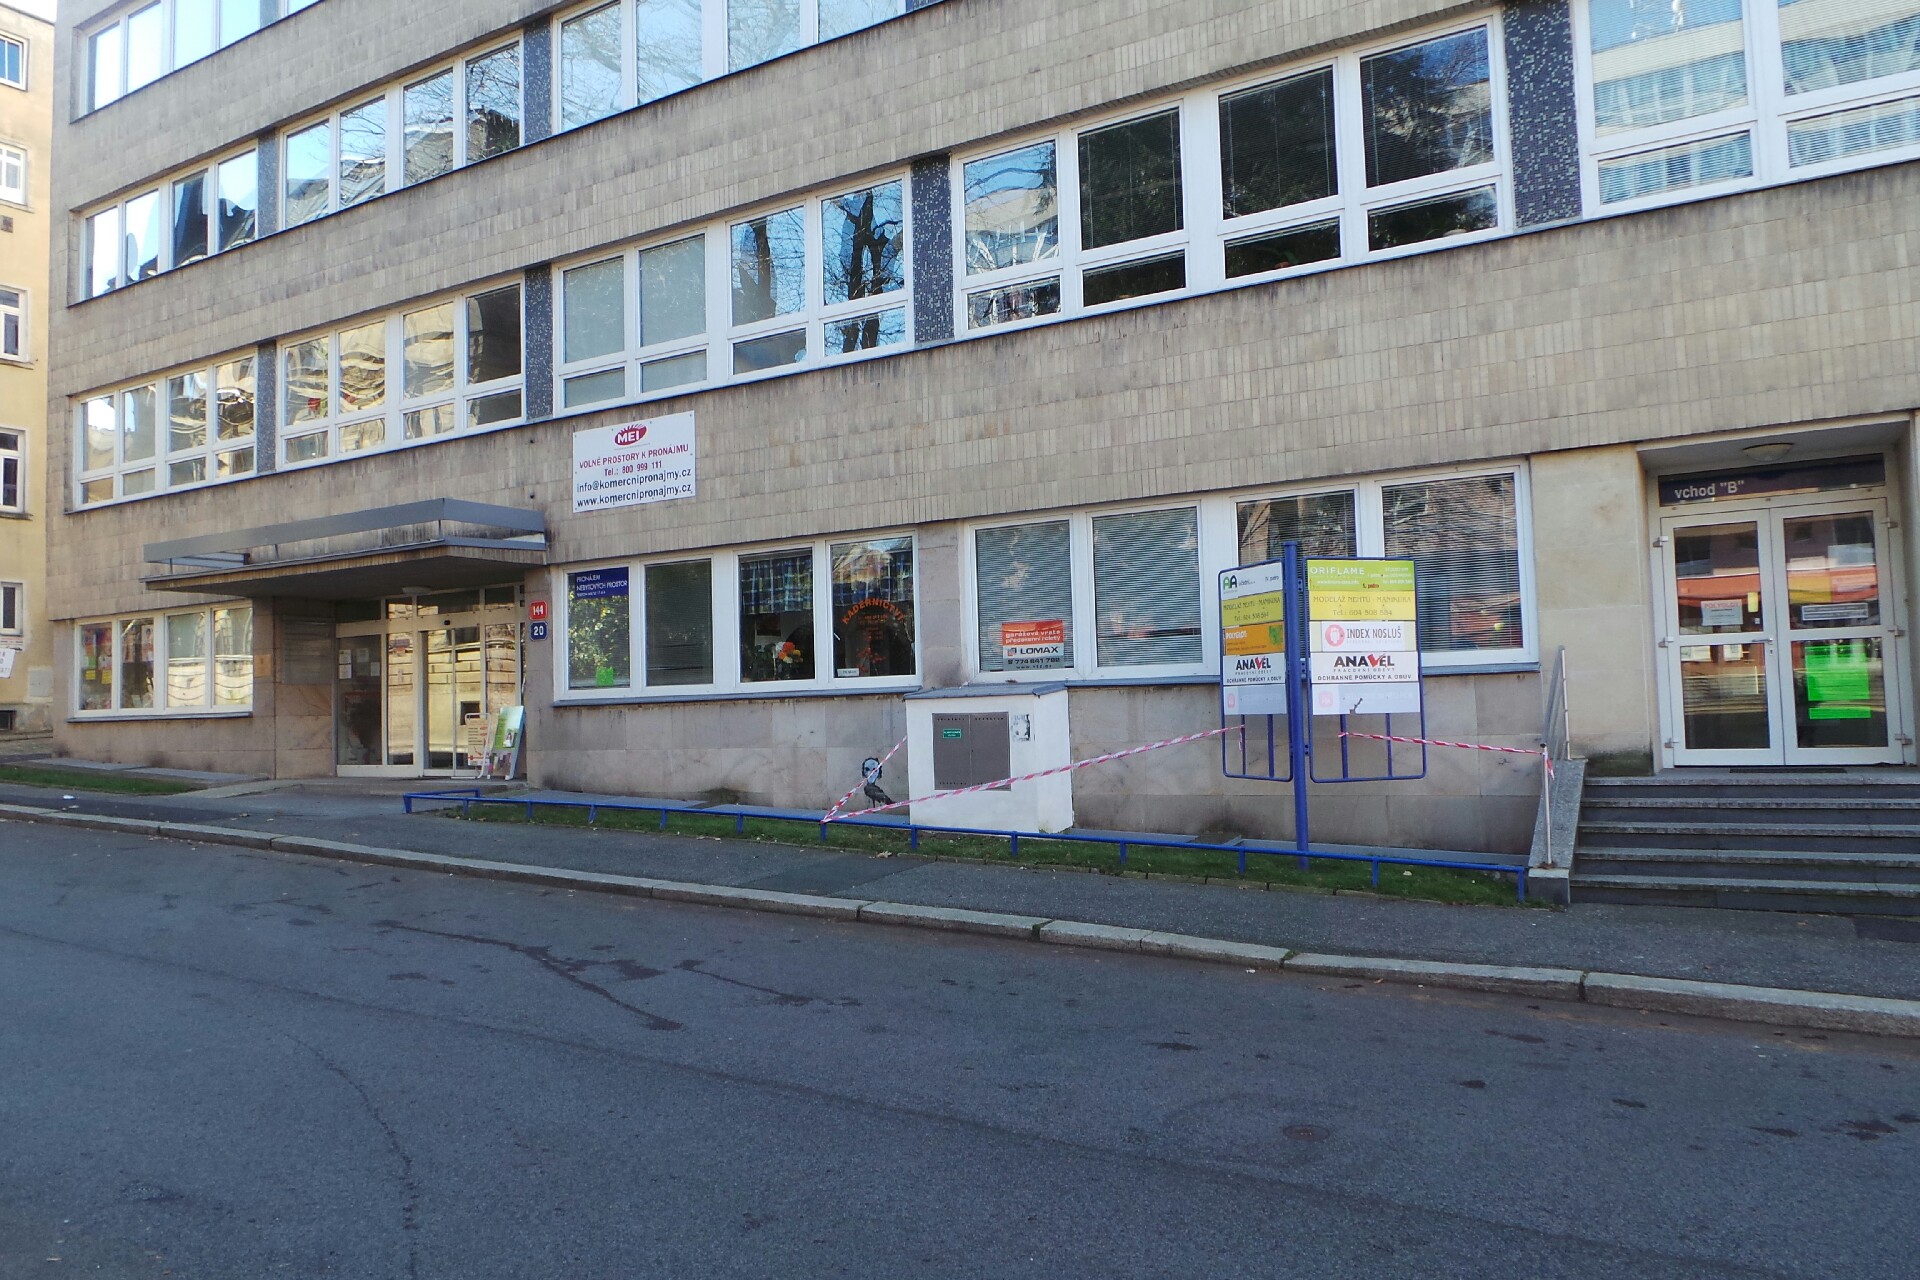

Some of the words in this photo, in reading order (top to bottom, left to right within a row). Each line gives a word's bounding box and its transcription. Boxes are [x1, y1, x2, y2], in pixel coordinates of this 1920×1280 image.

[618, 431, 640, 443] MEI
[580, 458, 600, 468] VOLNÉ
[602, 452, 640, 466] PROSTORY
[641, 450, 647, 459] K
[649, 444, 689, 457] PRONÁJMU
[604, 467, 619, 477] Tel.:
[622, 464, 634, 474] 800
[636, 462, 648, 472] 999
[651, 460, 663, 470] 111
[577, 469, 691, 492] info@komercnipronajmy.cz
[577, 485, 691, 507] www.komercnipronajmy.cz
[1674, 483, 1716, 499] vchod
[1310, 566, 1366, 575] ORIFLAME
[607, 580, 628, 589] PROSTOR
[532, 604, 544, 616] 144
[533, 625, 544, 636] 20
[1346, 628, 1370, 639] INDEX
[1373, 625, 1402, 639] NOSLUŠ
[1020, 646, 1059, 655] LOMAX
